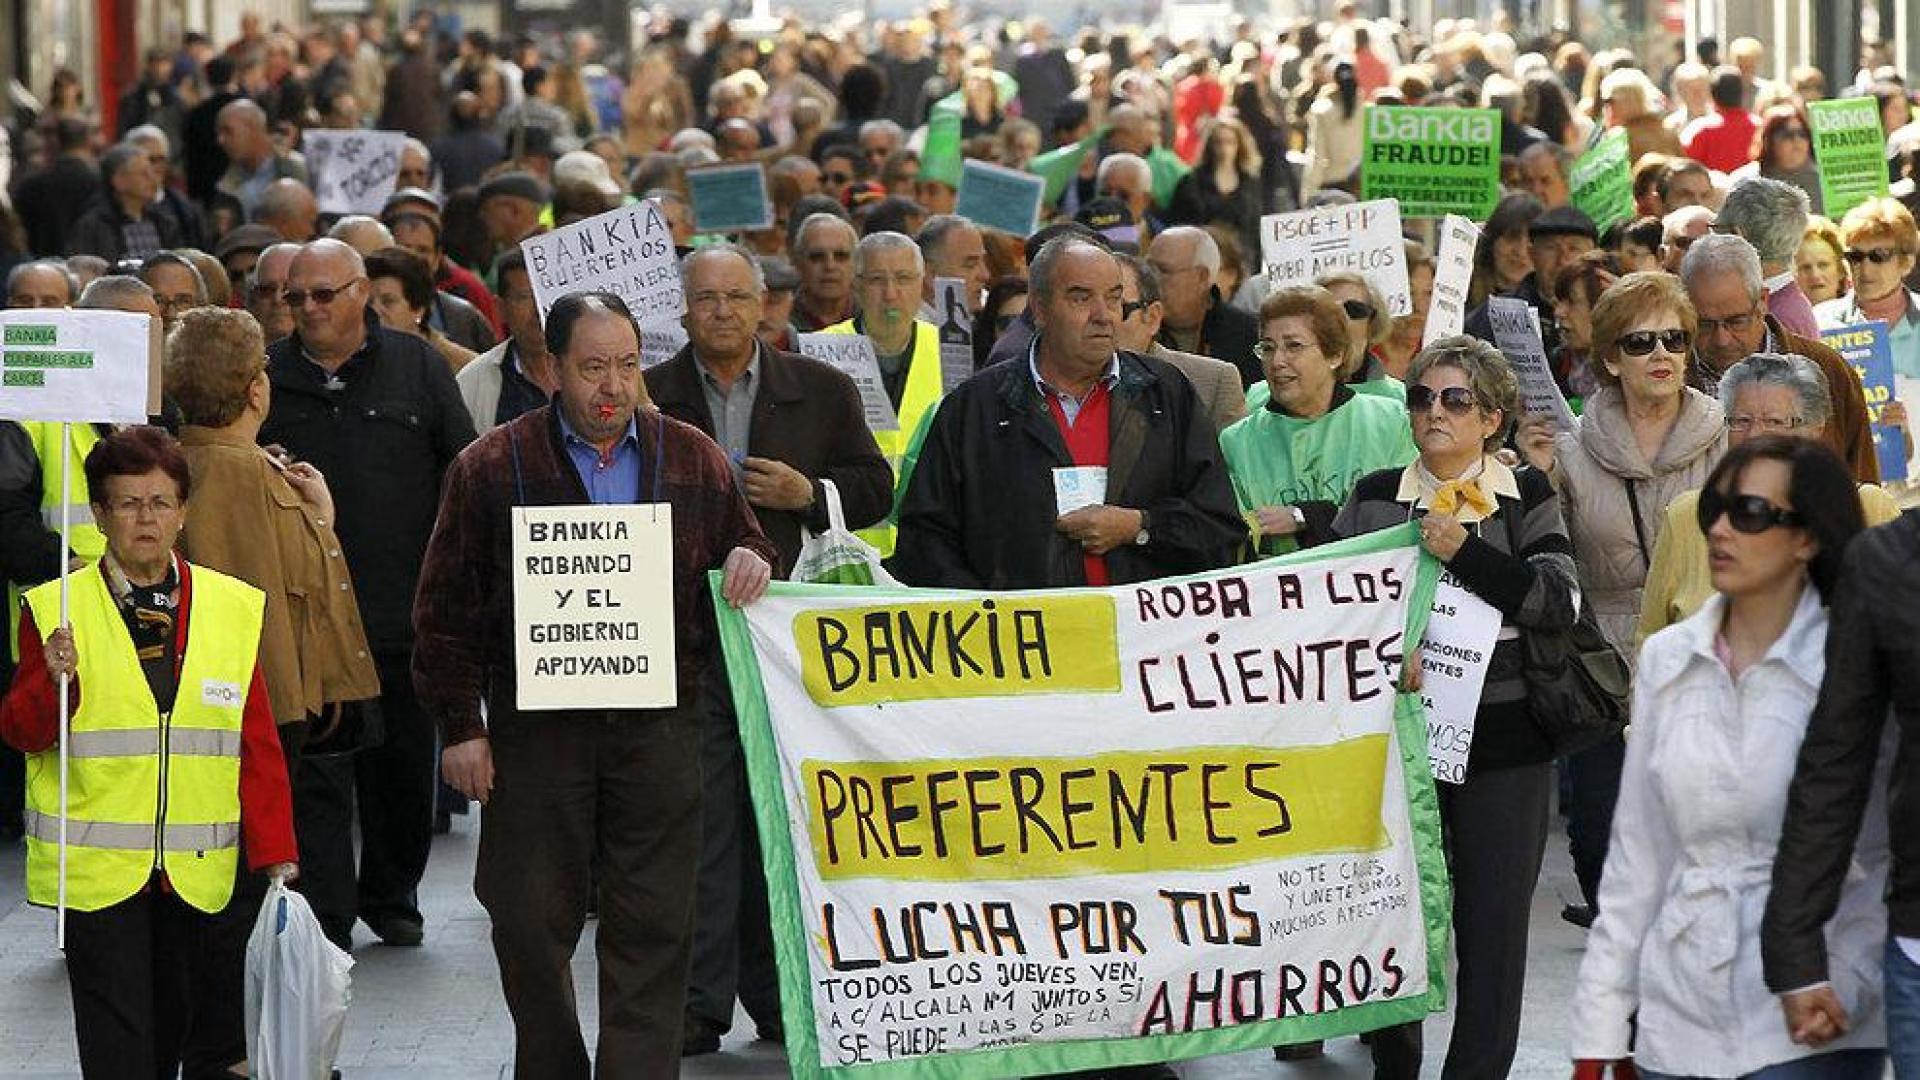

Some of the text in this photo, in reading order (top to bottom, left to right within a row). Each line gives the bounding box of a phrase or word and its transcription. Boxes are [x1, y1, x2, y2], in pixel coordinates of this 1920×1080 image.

[1370, 107, 1493, 142] Bankia
[1372, 143, 1490, 166] FRAUDE!
[1367, 174, 1490, 187] PARTICIPACIONES
[529, 521, 629, 541] BANKIA
[526, 554, 631, 575] ROBANDO
[554, 588, 621, 610] Y EL
[1136, 567, 1402, 622] ROBA A LOS
[1431, 602, 1457, 618] LAS
[529, 622, 639, 643] GOBIERNO
[534, 655, 649, 676] APOYANDO
[816, 763, 1292, 865] PREFERENTES
[1278, 869, 1302, 889] NO
[1305, 863, 1327, 883] TE
[1284, 892, 1295, 910] Y
[1302, 884, 1353, 906] UNETE
[822, 882, 1262, 971] LUCHA POR TUS
[1268, 893, 1408, 940] MUCHOS AFECTADOS
[818, 974, 913, 1004] TODOS
[929, 961, 983, 990] LOS
[996, 961, 1077, 988] JUEVES
[1140, 946, 1404, 1036] AHORROS
[831, 1011, 843, 1029] A
[880, 994, 972, 1023] ALCALA
[1031, 988, 1107, 1014] JUNTOS
[837, 1034, 874, 1066] SE
[885, 1027, 948, 1060] PUEDE
[979, 1017, 1017, 1035] LAS
[1029, 1013, 1045, 1034] 6
[1055, 1011, 1076, 1029] DE
[1087, 1007, 1111, 1023] LA
